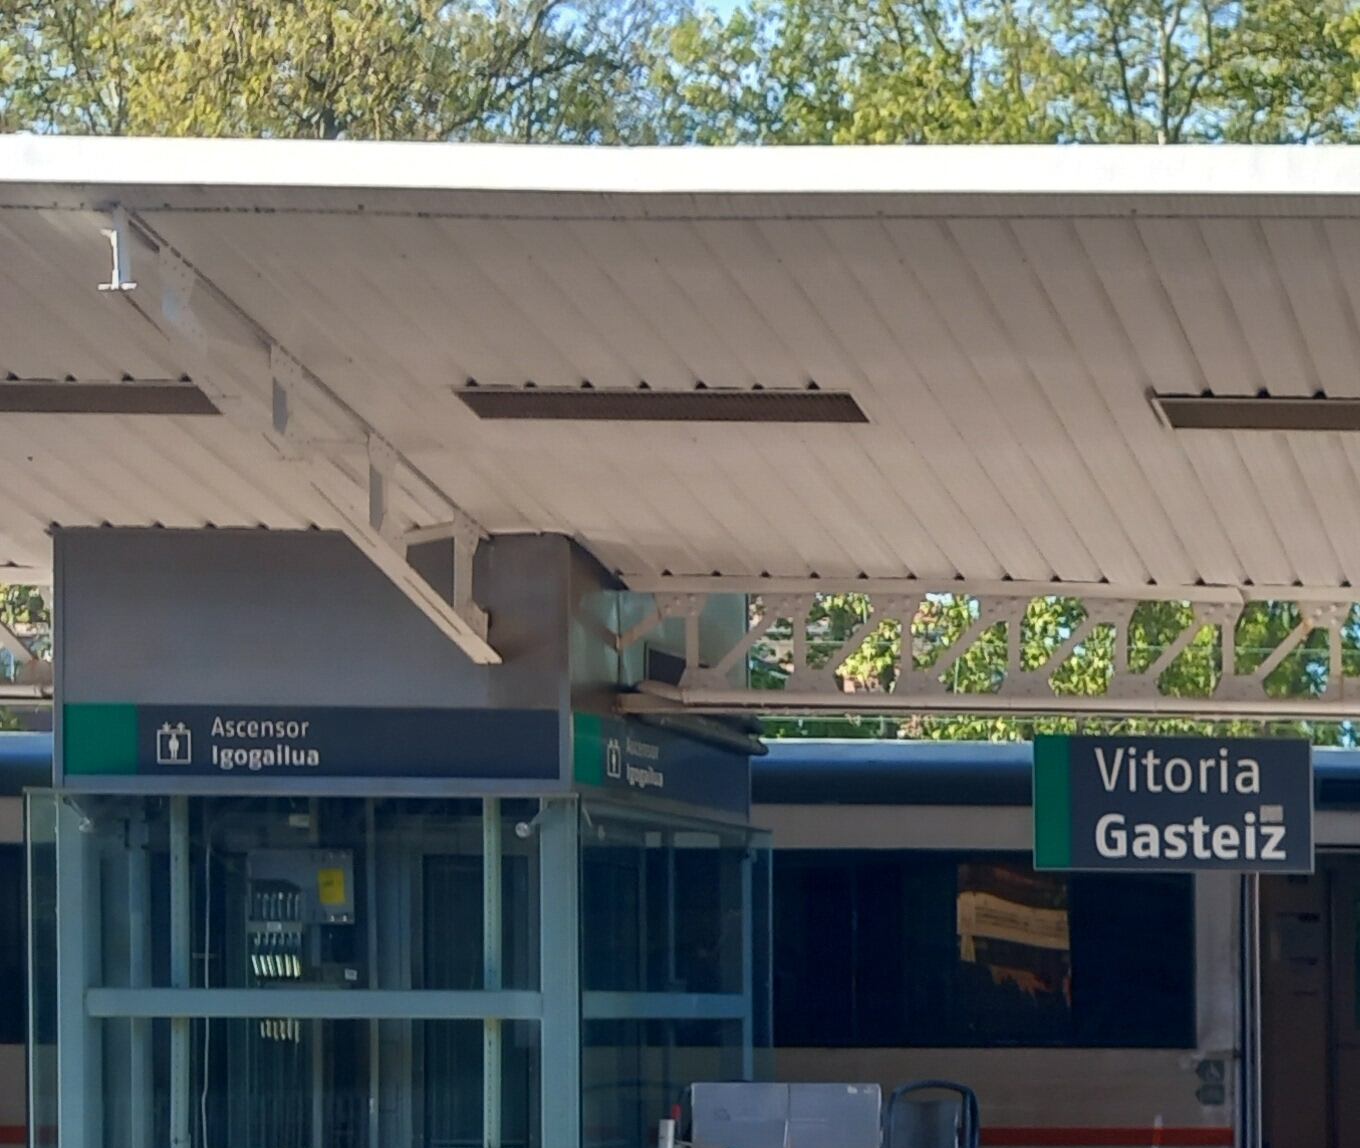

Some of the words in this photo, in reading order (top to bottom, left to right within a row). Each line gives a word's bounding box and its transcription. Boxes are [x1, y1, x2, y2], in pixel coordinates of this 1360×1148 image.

[211, 716, 310, 738] Ascensor
[212, 744, 320, 771] Igogailua
[1094, 747, 1261, 793] Vitoria
[1095, 811, 1287, 860] Gasteiz
